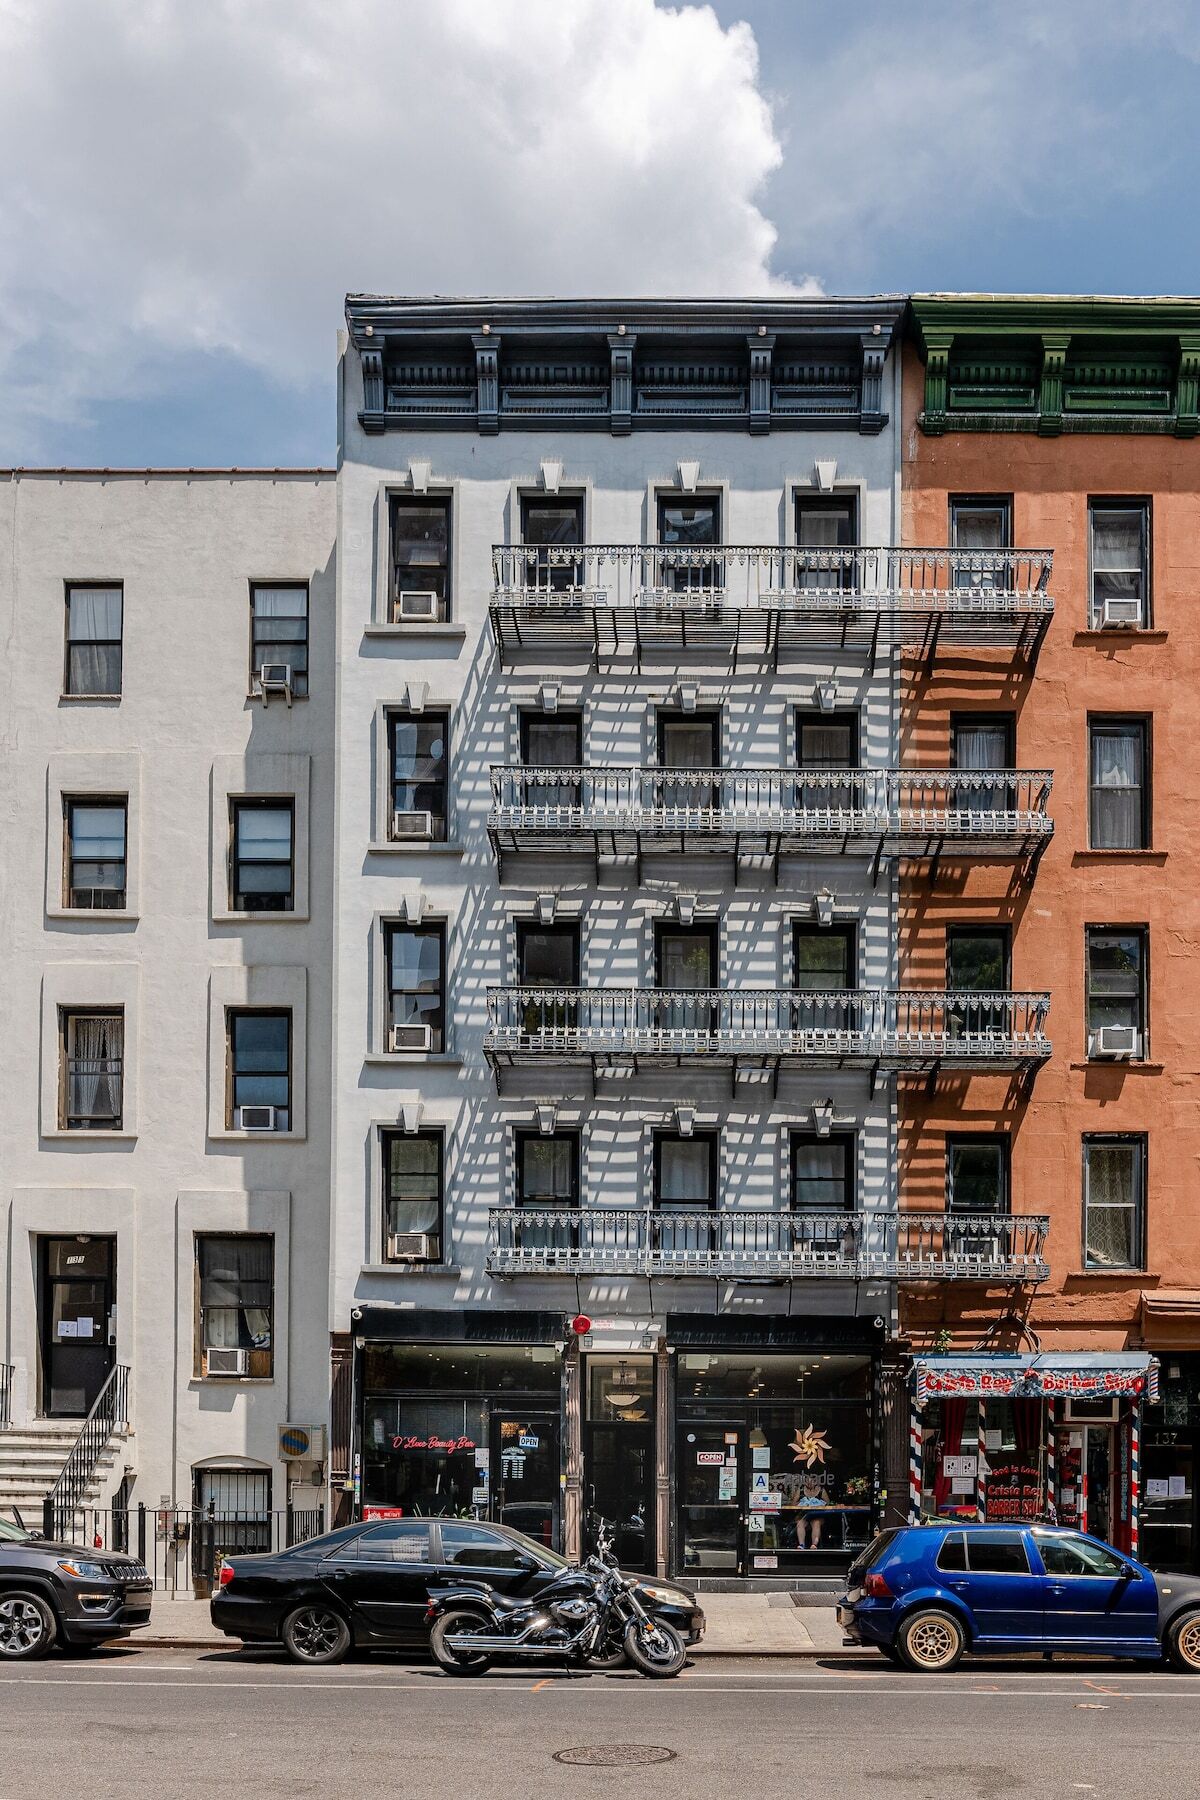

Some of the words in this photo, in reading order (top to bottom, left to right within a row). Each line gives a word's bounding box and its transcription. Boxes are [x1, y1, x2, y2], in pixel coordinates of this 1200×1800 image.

[1042, 1372, 1099, 1391] Barber
[427, 1436, 458, 1454] Beauty
[456, 1436, 476, 1449] Bar
[520, 1437, 538, 1446] OPEN
[1154, 1432, 1178, 1445] 137
[755, 1475, 766, 1487] A
[987, 1484, 1020, 1497] Cristo
[987, 1499, 1020, 1516] BARBER
